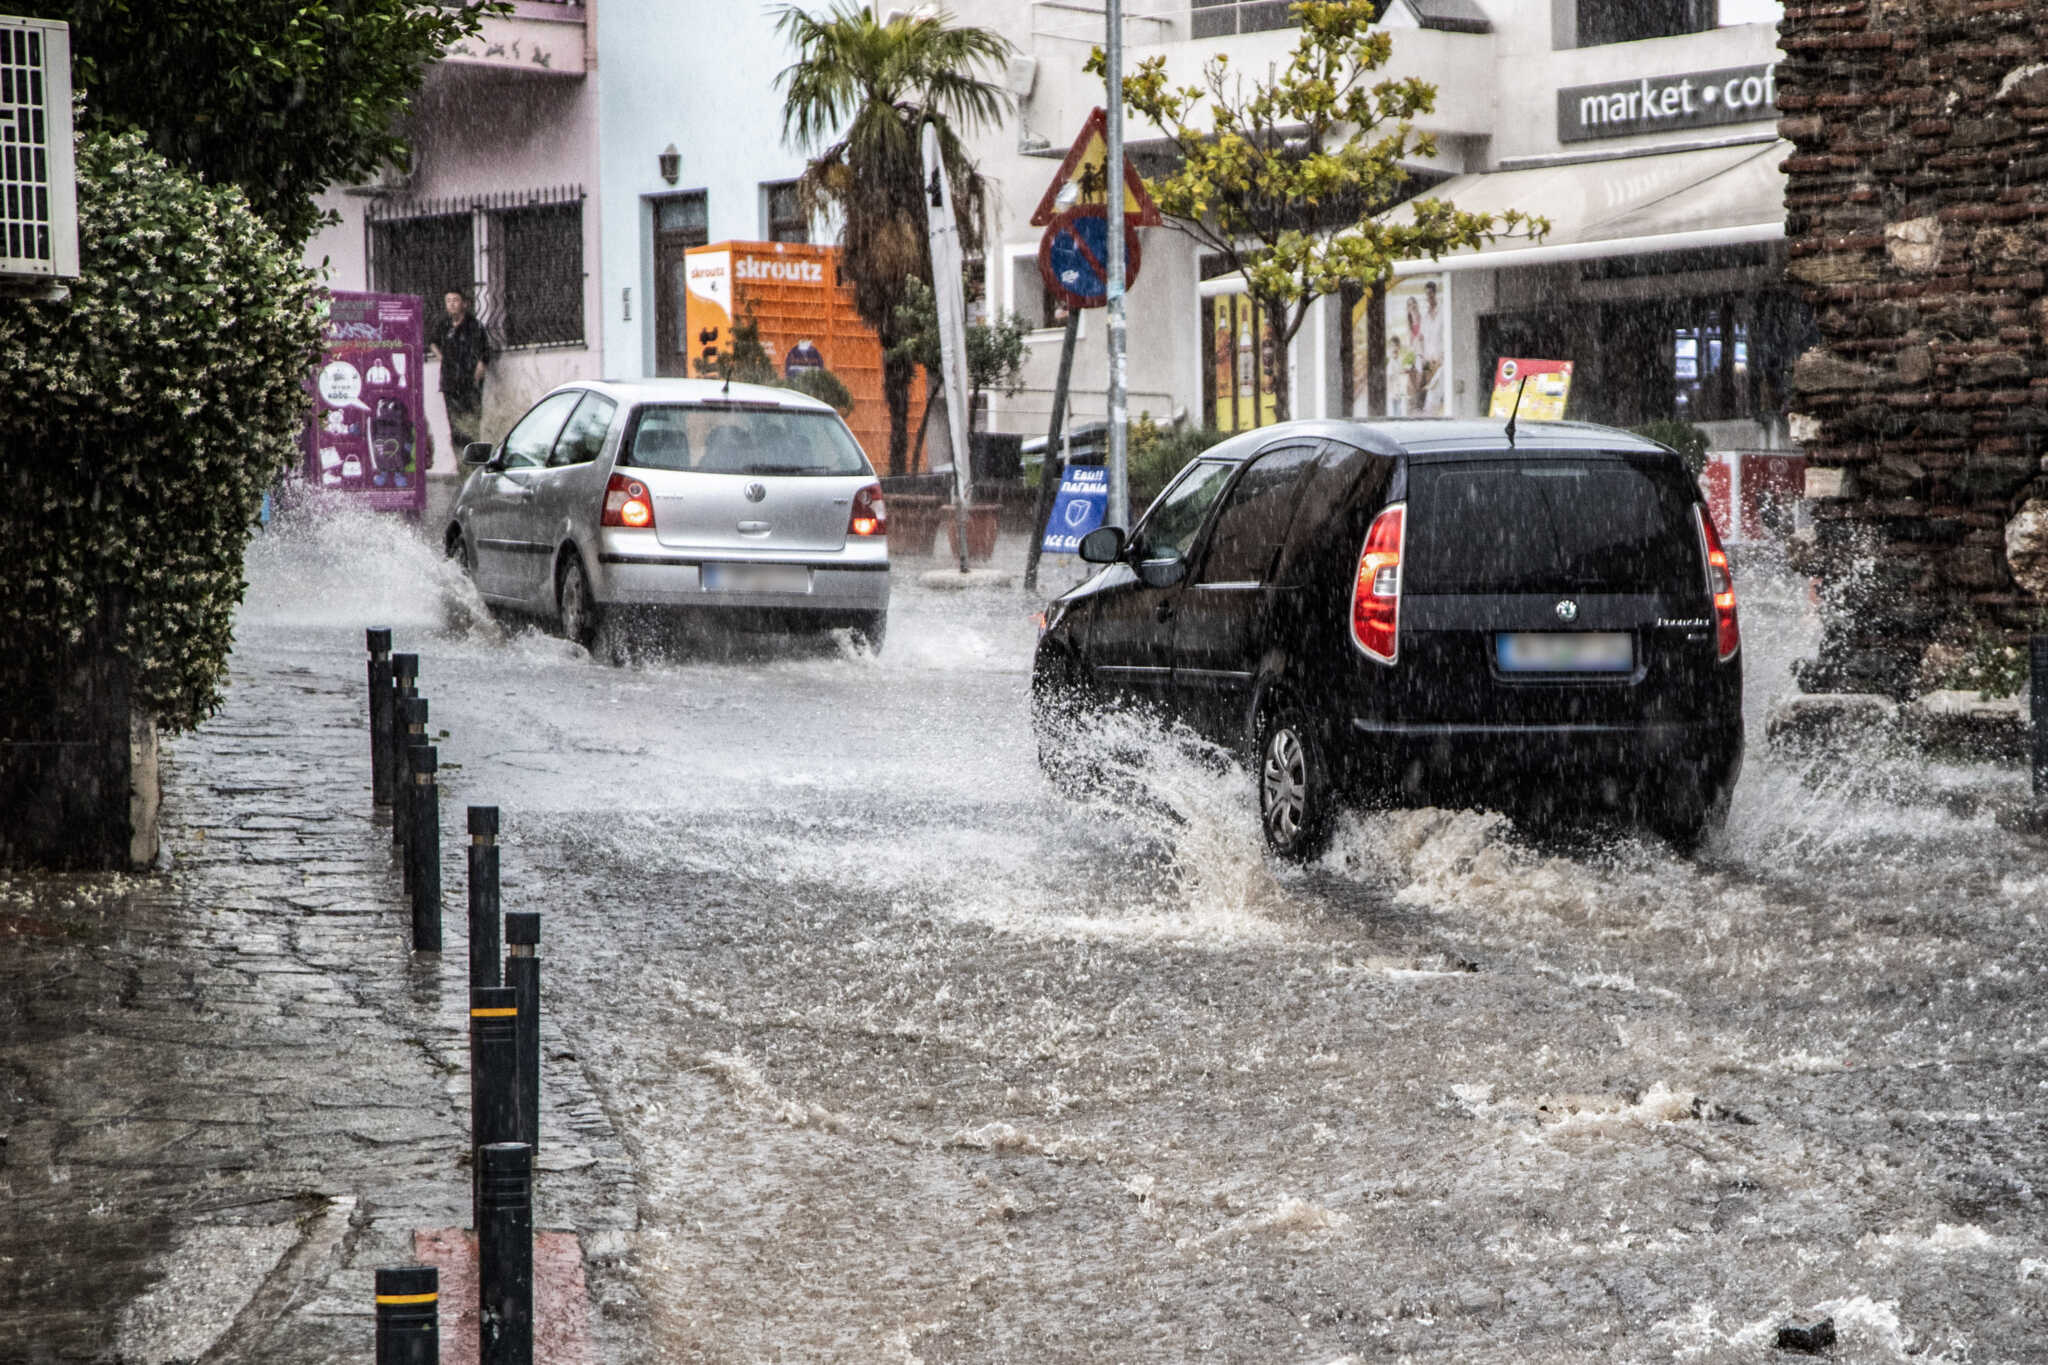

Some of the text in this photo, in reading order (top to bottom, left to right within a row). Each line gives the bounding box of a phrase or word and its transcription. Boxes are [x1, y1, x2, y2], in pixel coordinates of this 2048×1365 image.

[1581, 79, 1696, 125] market
[691, 266, 725, 279] skroutz
[736, 255, 822, 281] skroutz
[1045, 534, 1063, 547] ICE
